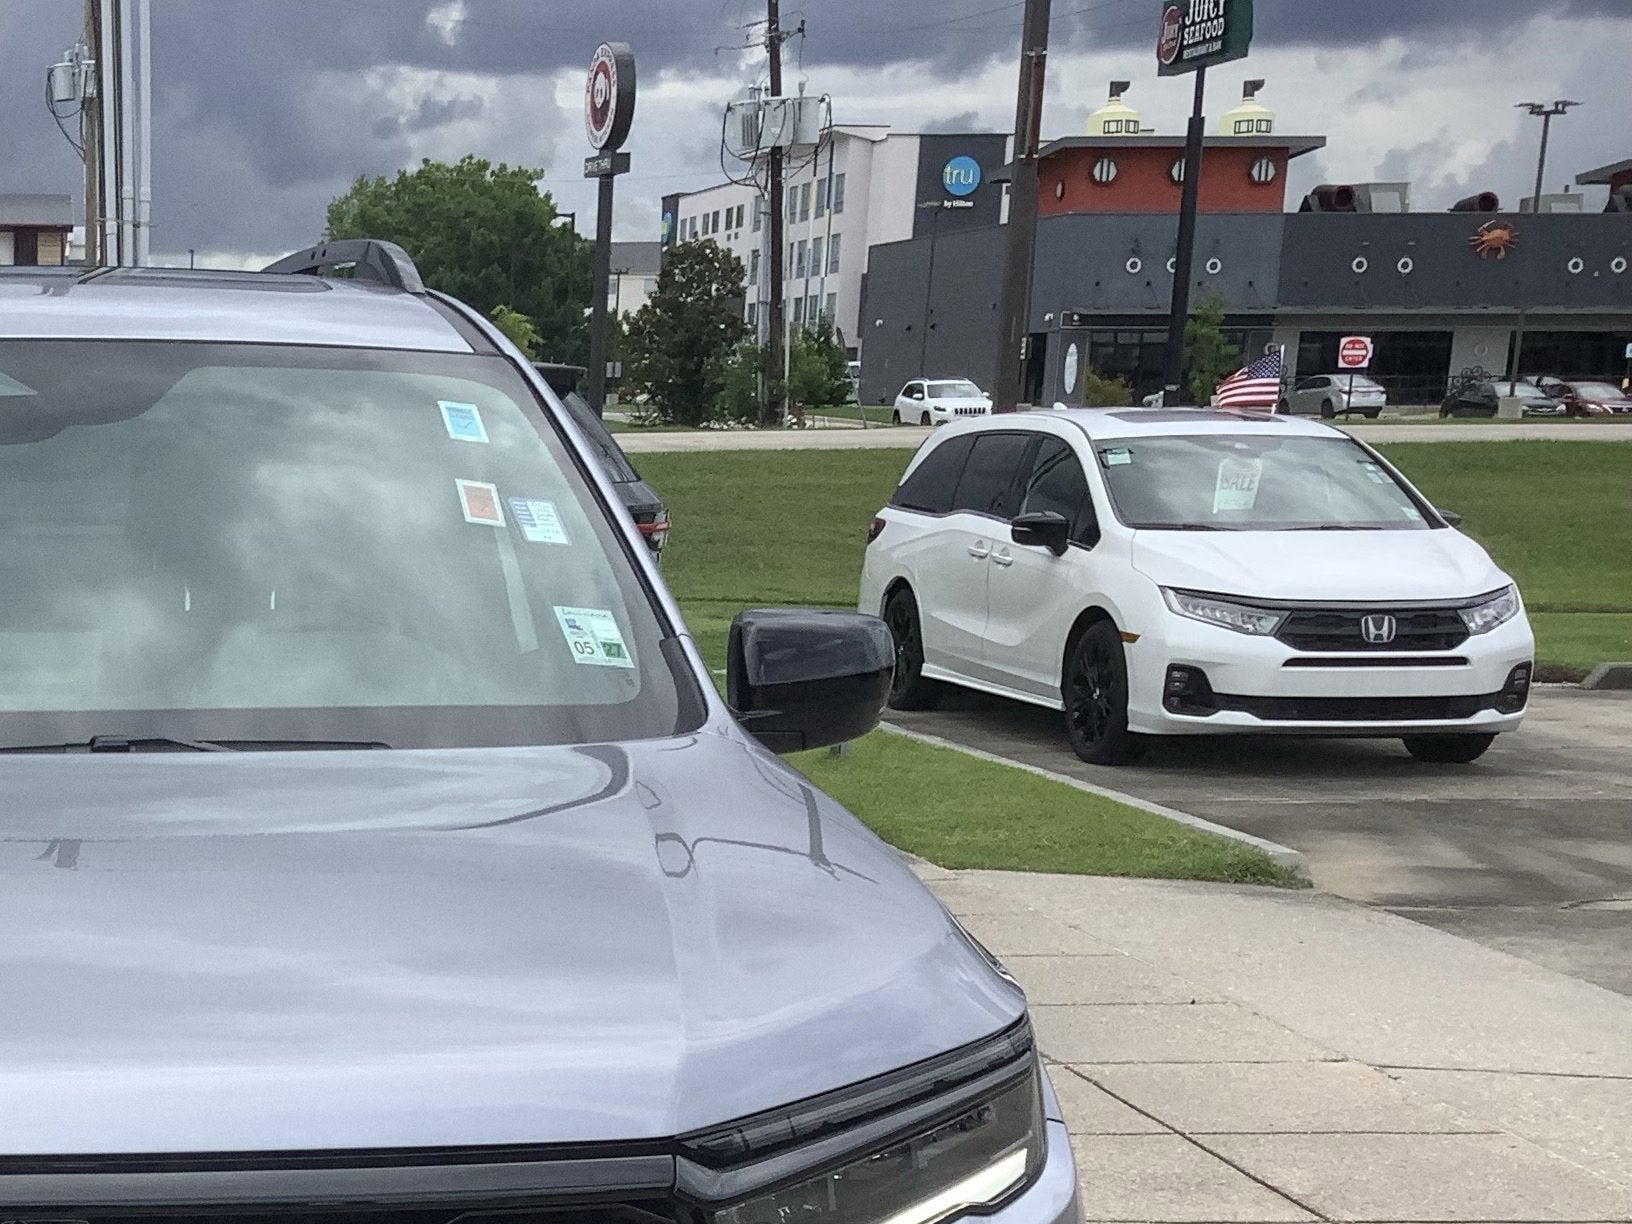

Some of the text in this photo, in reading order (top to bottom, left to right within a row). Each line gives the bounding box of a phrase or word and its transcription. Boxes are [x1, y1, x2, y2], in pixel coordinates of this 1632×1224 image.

[1183, 17, 1225, 45] SEAFOOD
[944, 166, 973, 185] tru
[574, 641, 623, 657] 05 27
